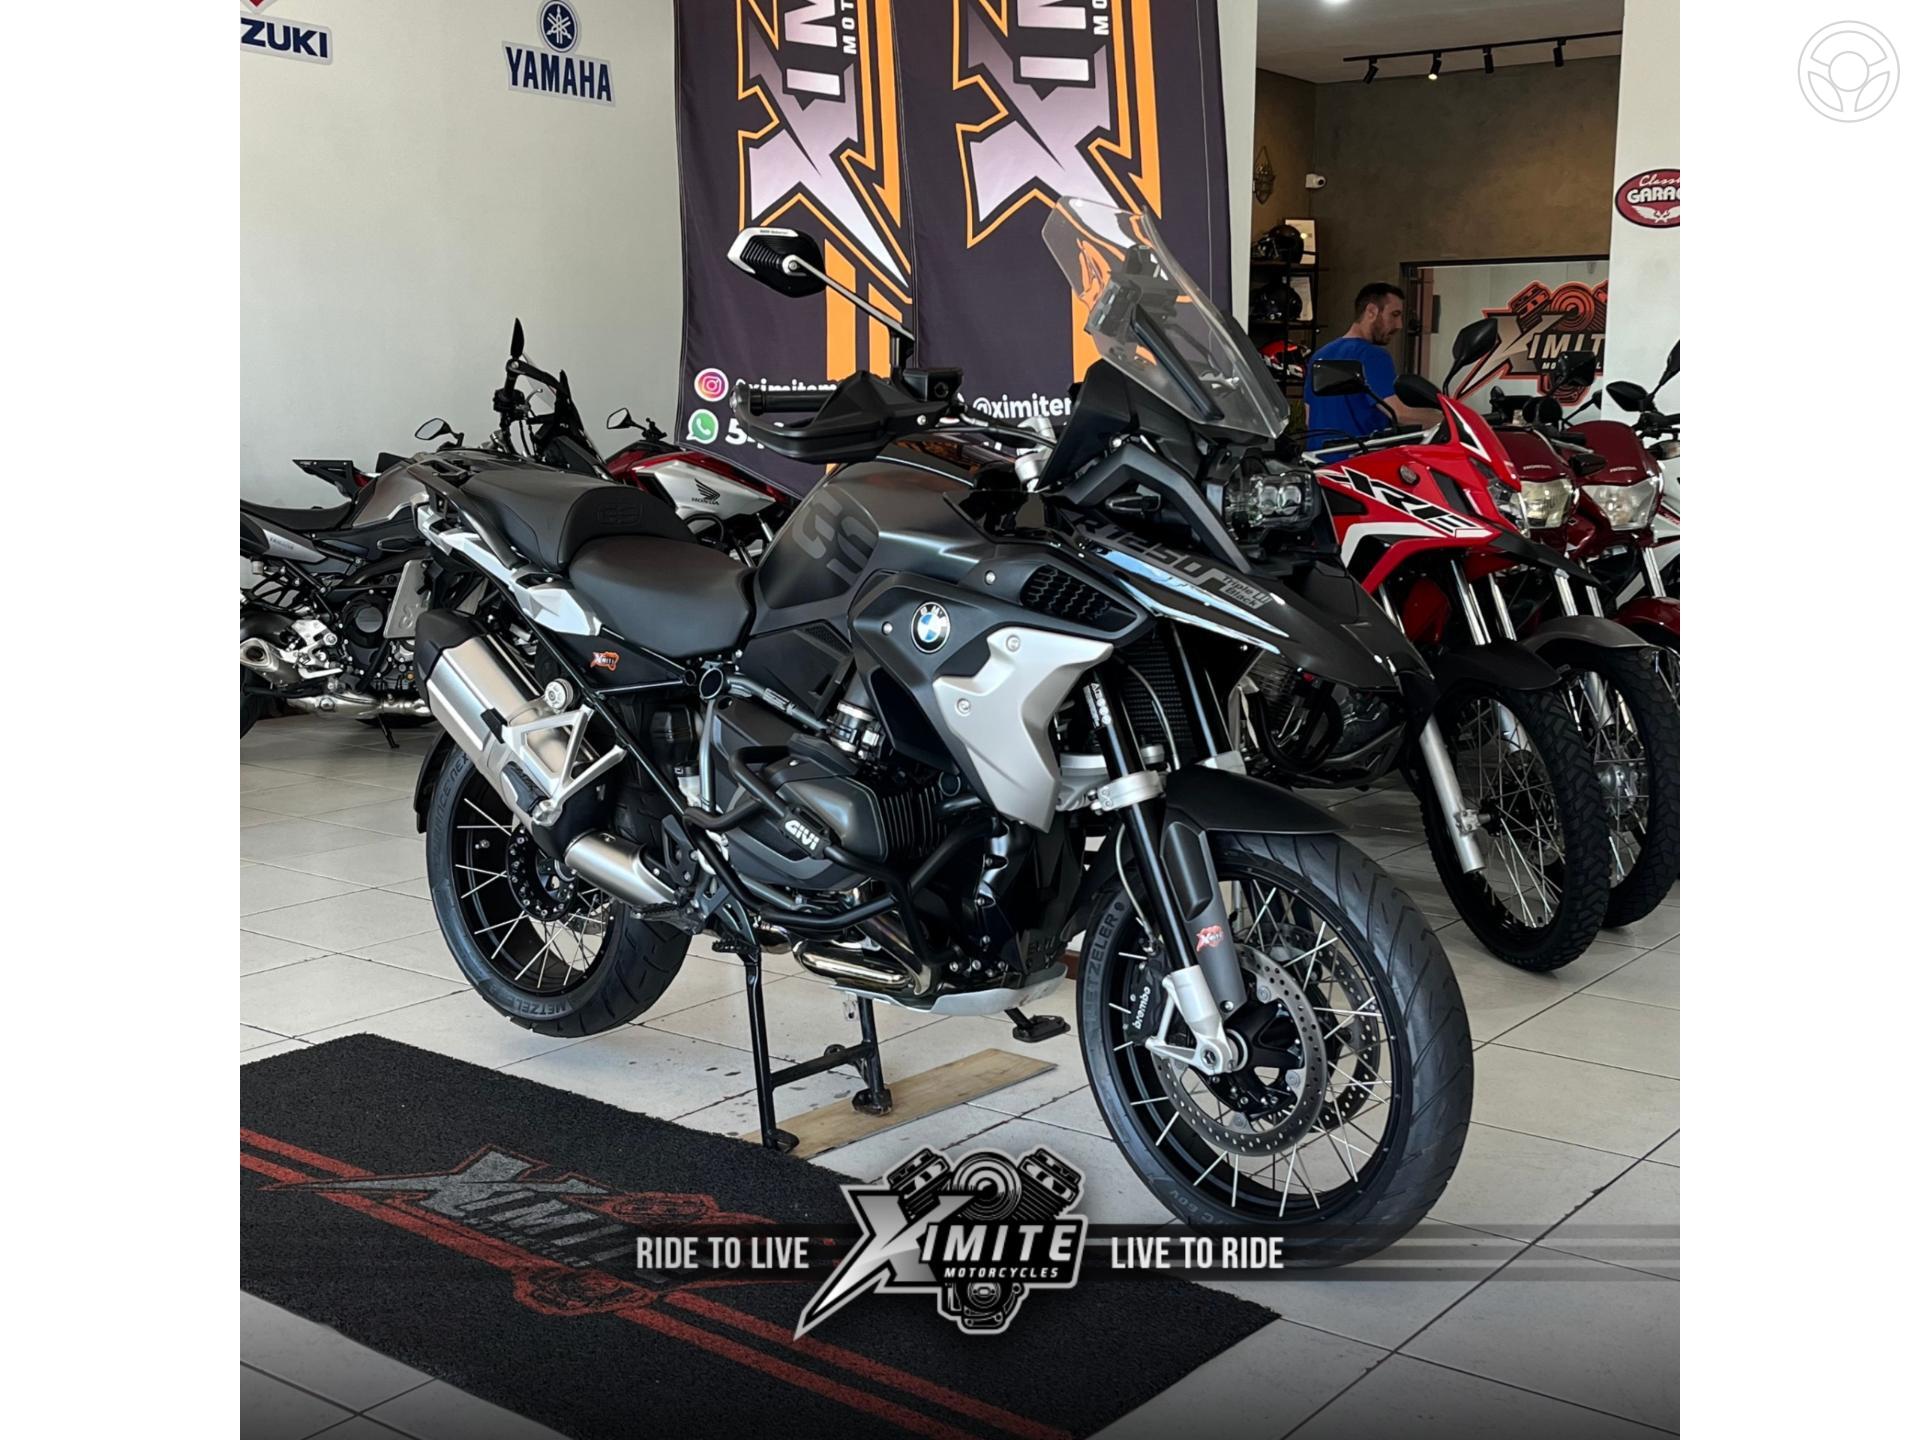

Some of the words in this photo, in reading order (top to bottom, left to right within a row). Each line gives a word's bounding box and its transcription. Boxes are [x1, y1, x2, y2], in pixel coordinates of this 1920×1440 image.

[240, 17, 328, 58] ZUKI
[505, 46, 612, 102] YAMAHA
[785, 820, 820, 850] GIVI
[1132, 986, 1151, 1030] brembo
